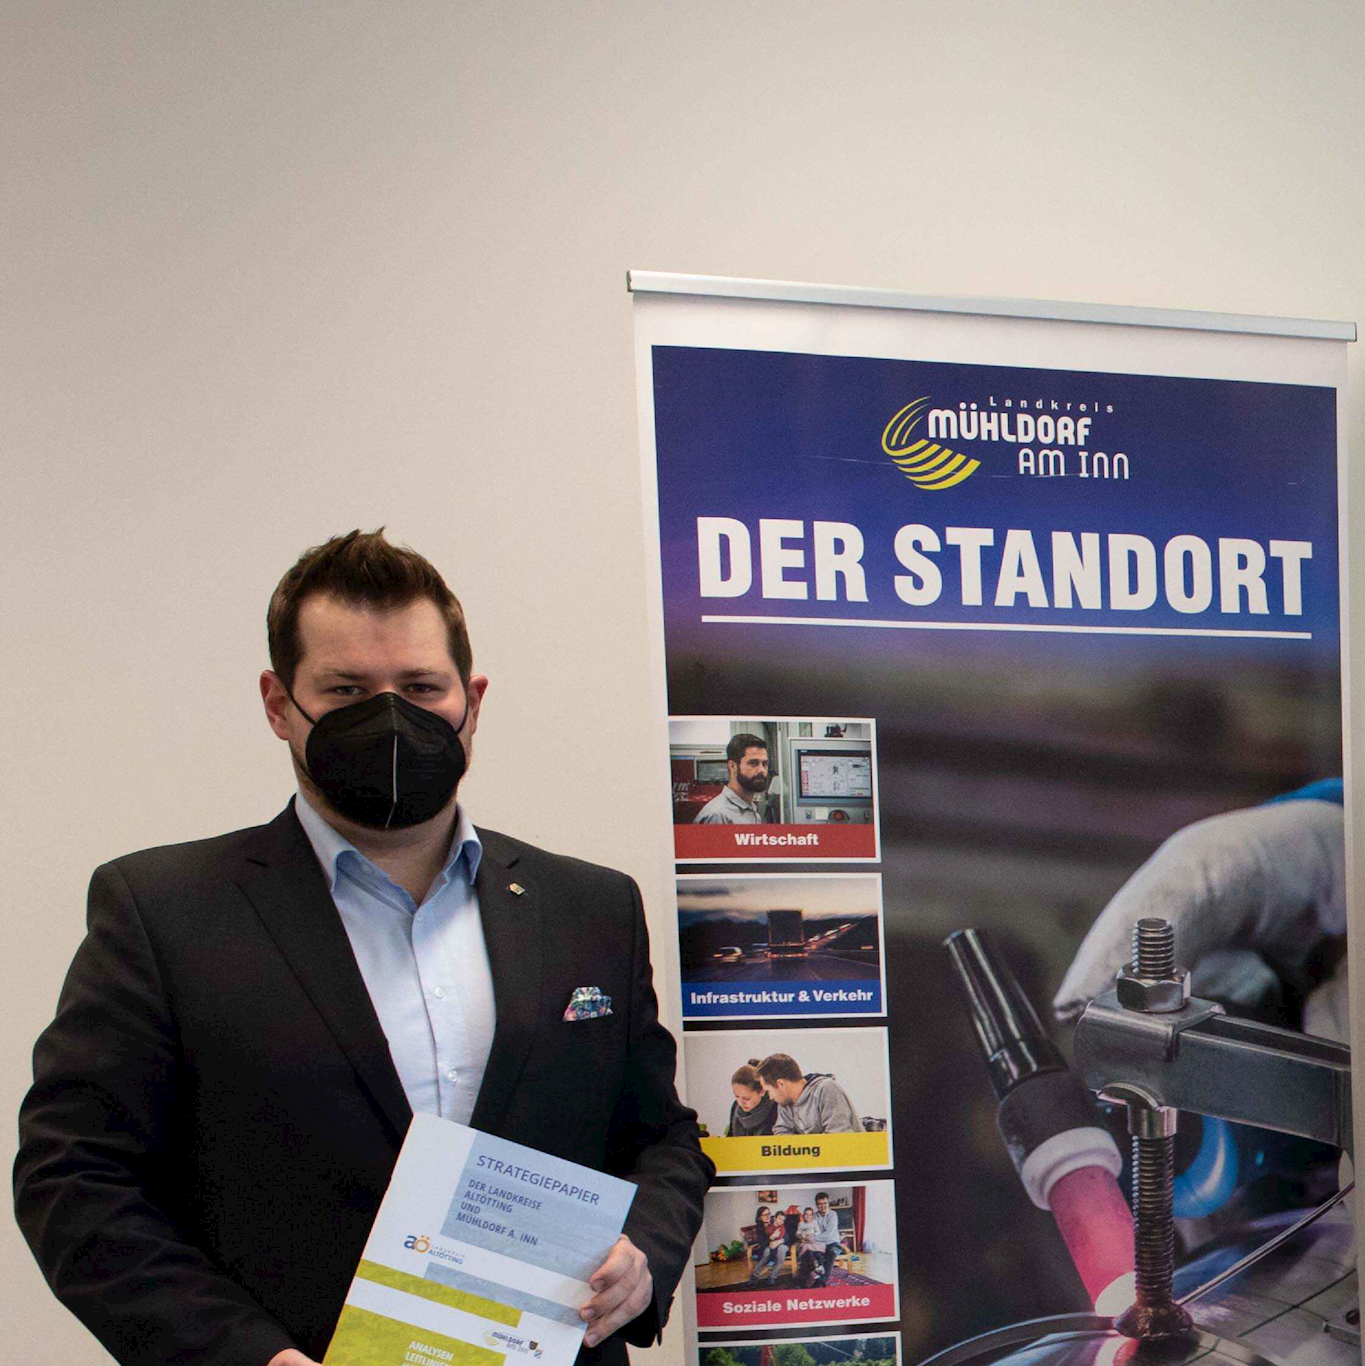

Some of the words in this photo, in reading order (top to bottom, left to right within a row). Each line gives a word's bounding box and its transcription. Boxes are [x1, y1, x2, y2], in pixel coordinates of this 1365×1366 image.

[989, 395, 1114, 414] Landkreis
[927, 401, 1092, 446] MÜHLDORF
[1018, 448, 1066, 477] AM
[697, 516, 869, 603] DER
[893, 523, 1312, 617] STANDORT
[734, 832, 819, 846] Wirtschaft
[690, 990, 795, 1004] Infrastruktur
[798, 991, 810, 1003] &
[812, 989, 873, 1002] Verkehr
[761, 1145, 820, 1158] Bildung
[476, 1155, 600, 1205] STRATEGIEPAPIER
[464, 1190, 513, 1213] ALTÖTTING
[468, 1179, 486, 1192] DER
[487, 1185, 543, 1210] LANDKREISE
[460, 1201, 481, 1214] UND
[456, 1212, 507, 1235] MÜHLDORF
[507, 1229, 517, 1240] A.
[519, 1234, 539, 1246] INN
[722, 1300, 782, 1314] Soziale
[786, 1295, 871, 1312] Netzwerke
[409, 1340, 454, 1361] ANALYSEN
